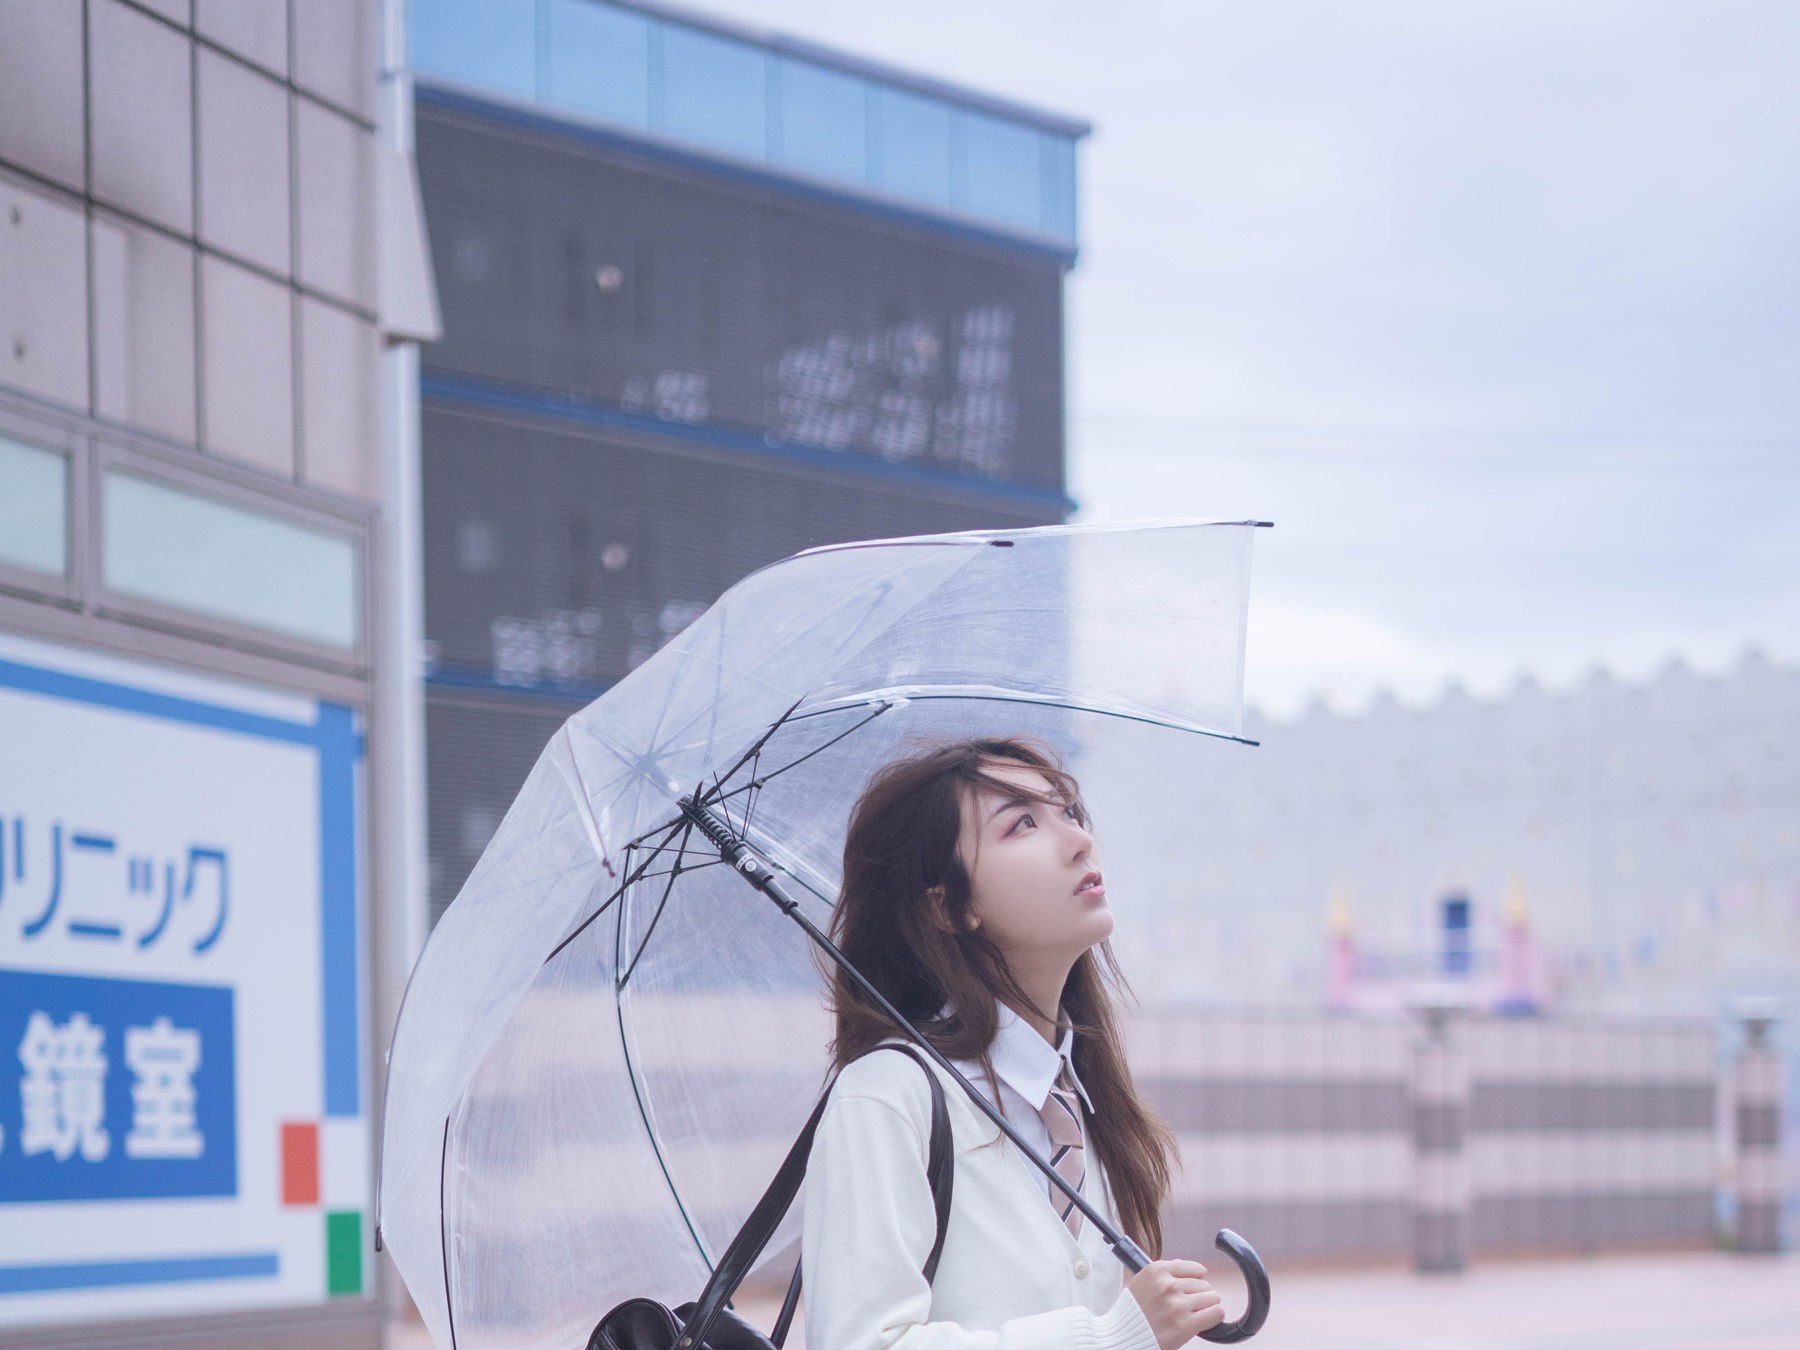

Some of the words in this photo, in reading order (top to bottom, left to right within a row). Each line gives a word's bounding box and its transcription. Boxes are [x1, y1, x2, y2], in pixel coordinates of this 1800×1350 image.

[0, 815, 229, 954] リニック
[0, 1009, 205, 1162] 鏡室
